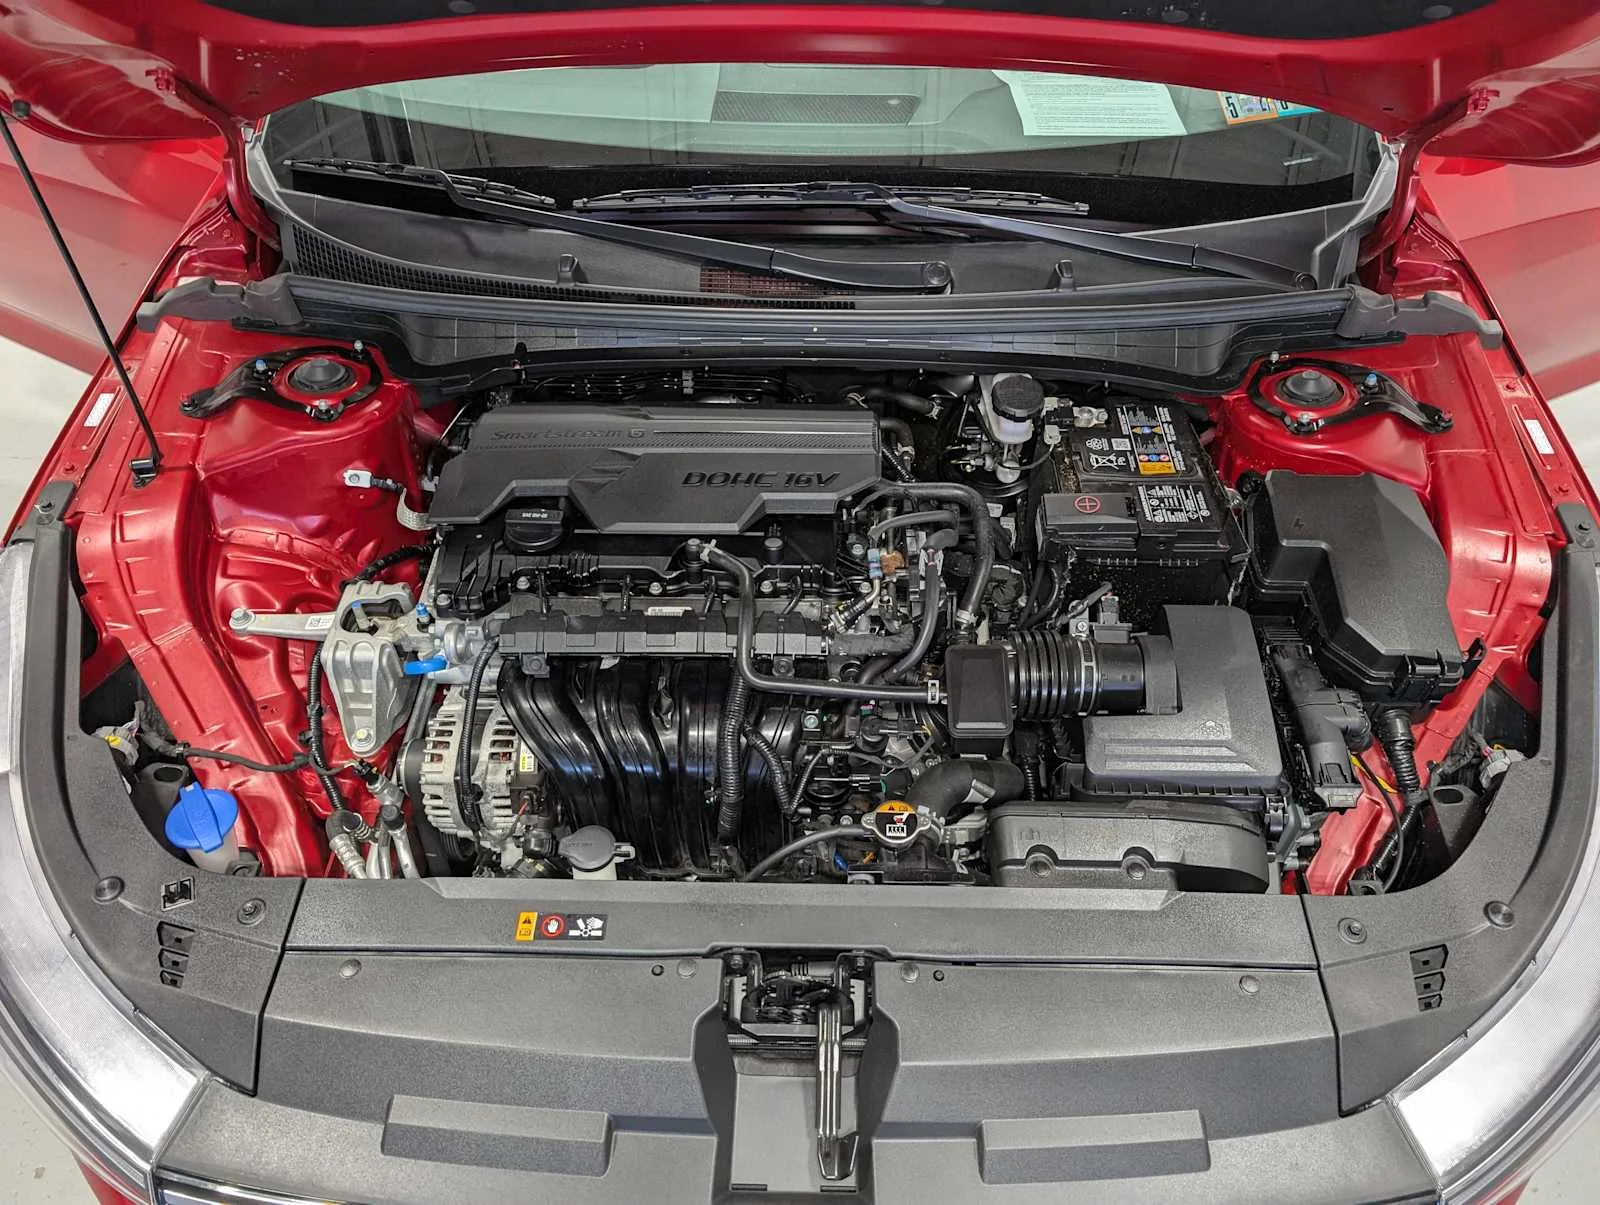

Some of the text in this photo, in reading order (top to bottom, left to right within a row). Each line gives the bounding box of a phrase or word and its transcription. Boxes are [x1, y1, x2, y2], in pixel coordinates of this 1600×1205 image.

[1225, 96, 1239, 118] 5
[490, 428, 622, 441] Smartstream
[681, 471, 841, 487] DOHC 16V
